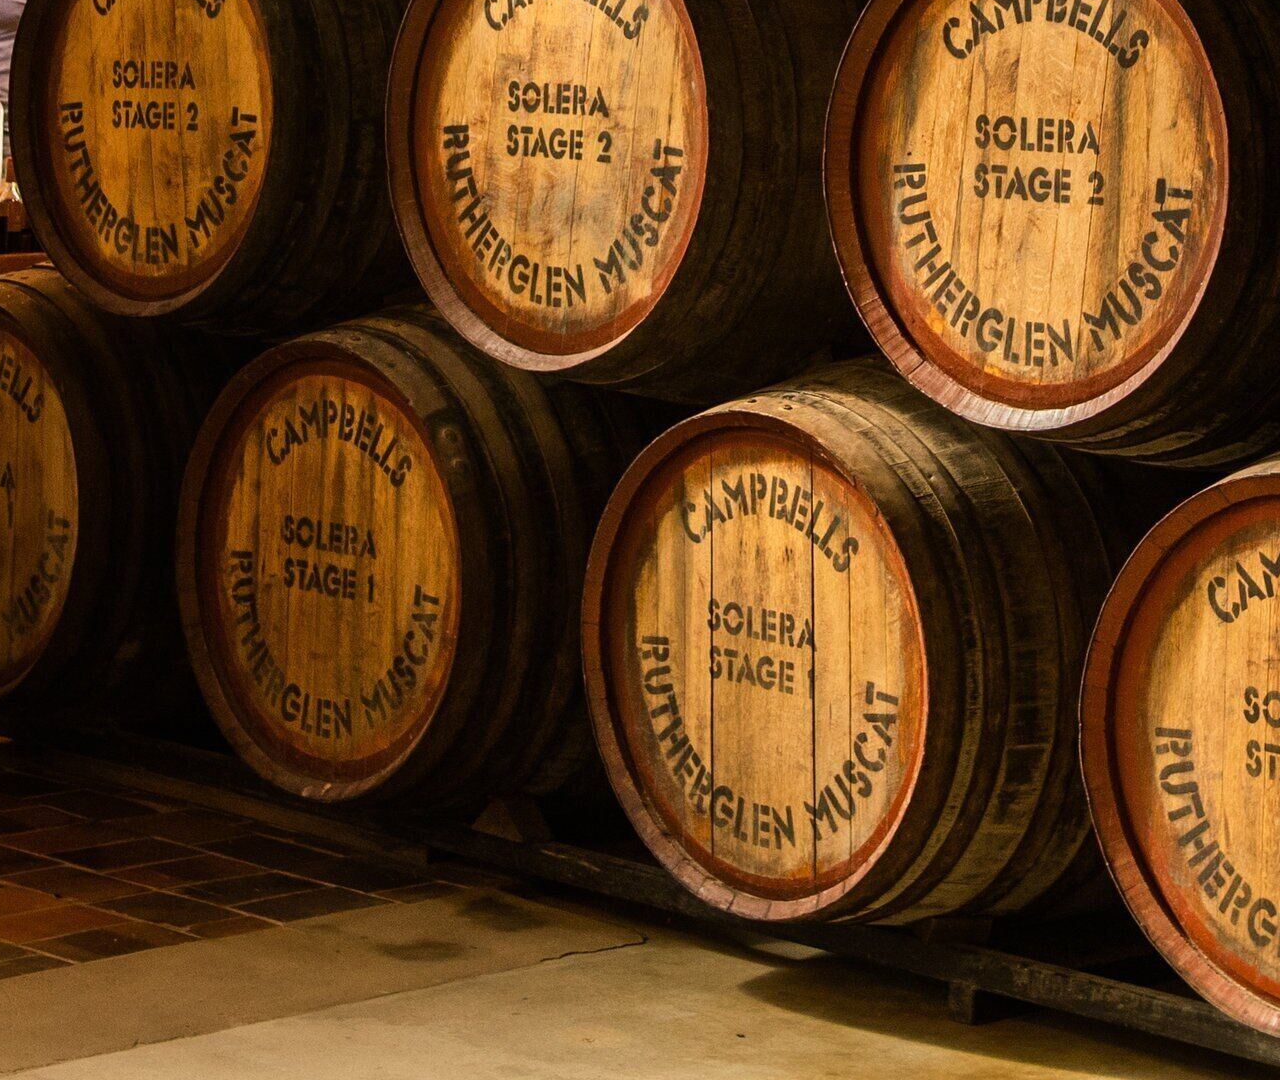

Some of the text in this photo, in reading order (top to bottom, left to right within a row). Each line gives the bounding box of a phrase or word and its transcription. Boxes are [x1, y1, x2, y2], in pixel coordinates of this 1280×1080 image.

[113, 60, 196, 90] SOLERA
[508, 80, 609, 118] SOLERA
[112, 100, 198, 131] STAGE 2
[976, 114, 1100, 156] SOLERA
[507, 125, 612, 163] STAGE 2
[60, 101, 257, 264] RUTHERGLEN MUSCAT
[974, 163, 1104, 206] STAGE 2
[444, 125, 683, 308] RUTHERGLEN MUSCAT
[894, 163, 1193, 367] RUTHERGLEN MUSCAT
[267, 399, 412, 488] CAMPBELLS
[282, 515, 376, 559] SOLERA
[681, 473, 859, 573] CAMPBELLS
[2, 510, 71, 641] MUSCAT
[283, 558, 374, 603] STAGE 1
[231, 550, 440, 739] RUTHERGLEN MUSCAT
[708, 598, 817, 652] SOLERA
[709, 646, 794, 695] STAGE
[641, 636, 899, 849] RUTHERGLEN MUSCAT
